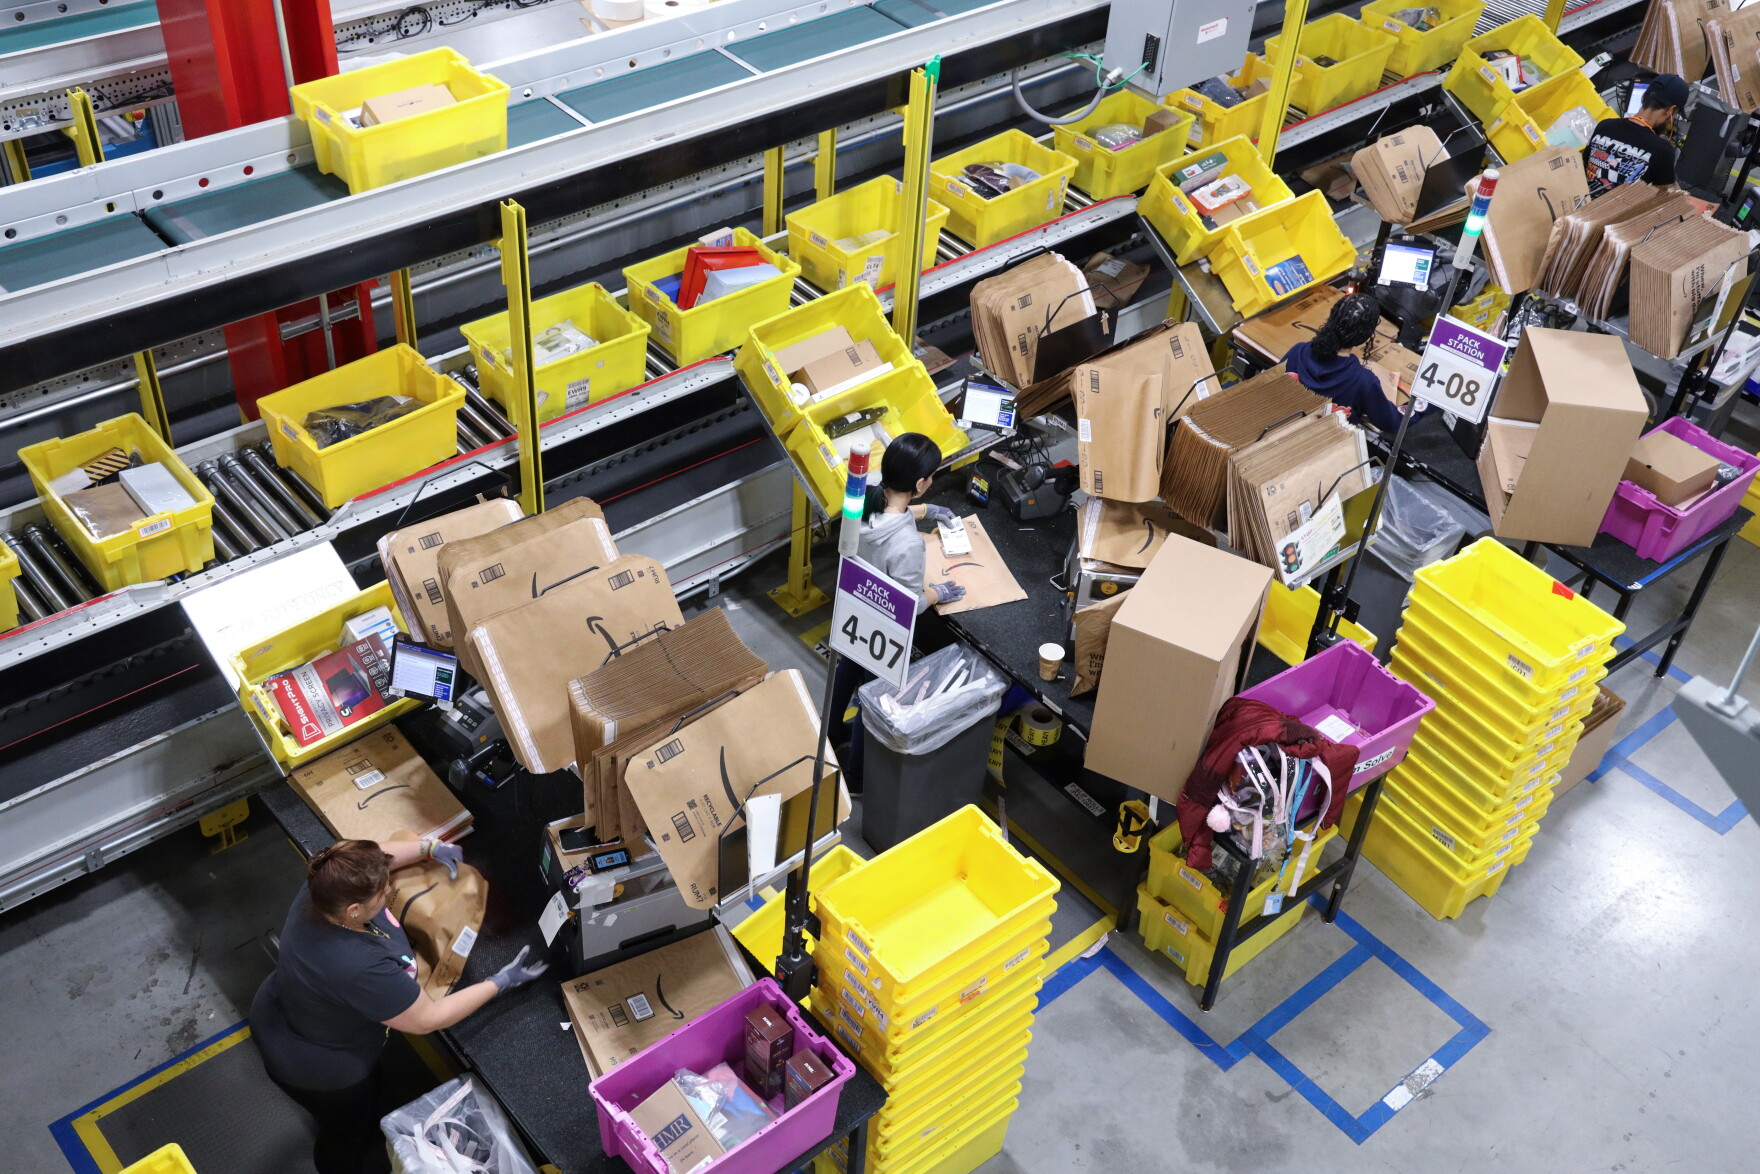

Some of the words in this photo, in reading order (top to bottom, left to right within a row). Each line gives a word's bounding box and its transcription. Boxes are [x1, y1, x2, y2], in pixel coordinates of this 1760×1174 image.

[1447, 338, 1484, 360] STATION
[1458, 334, 1480, 350] PACK
[1420, 362, 1480, 406] 4-08
[648, 566, 660, 584] RUM7
[856, 584, 896, 613] STATION
[866, 579, 890, 600] PACK
[842, 614, 904, 669] 4-07
[301, 671, 319, 698] SCREEN
[316, 697, 334, 728] PRIVACY
[1364, 752, 1392, 770] Solve
[703, 794, 722, 828] RECYCLABLE
[690, 882, 704, 903] RUM7
[653, 1118, 690, 1152] HMR
